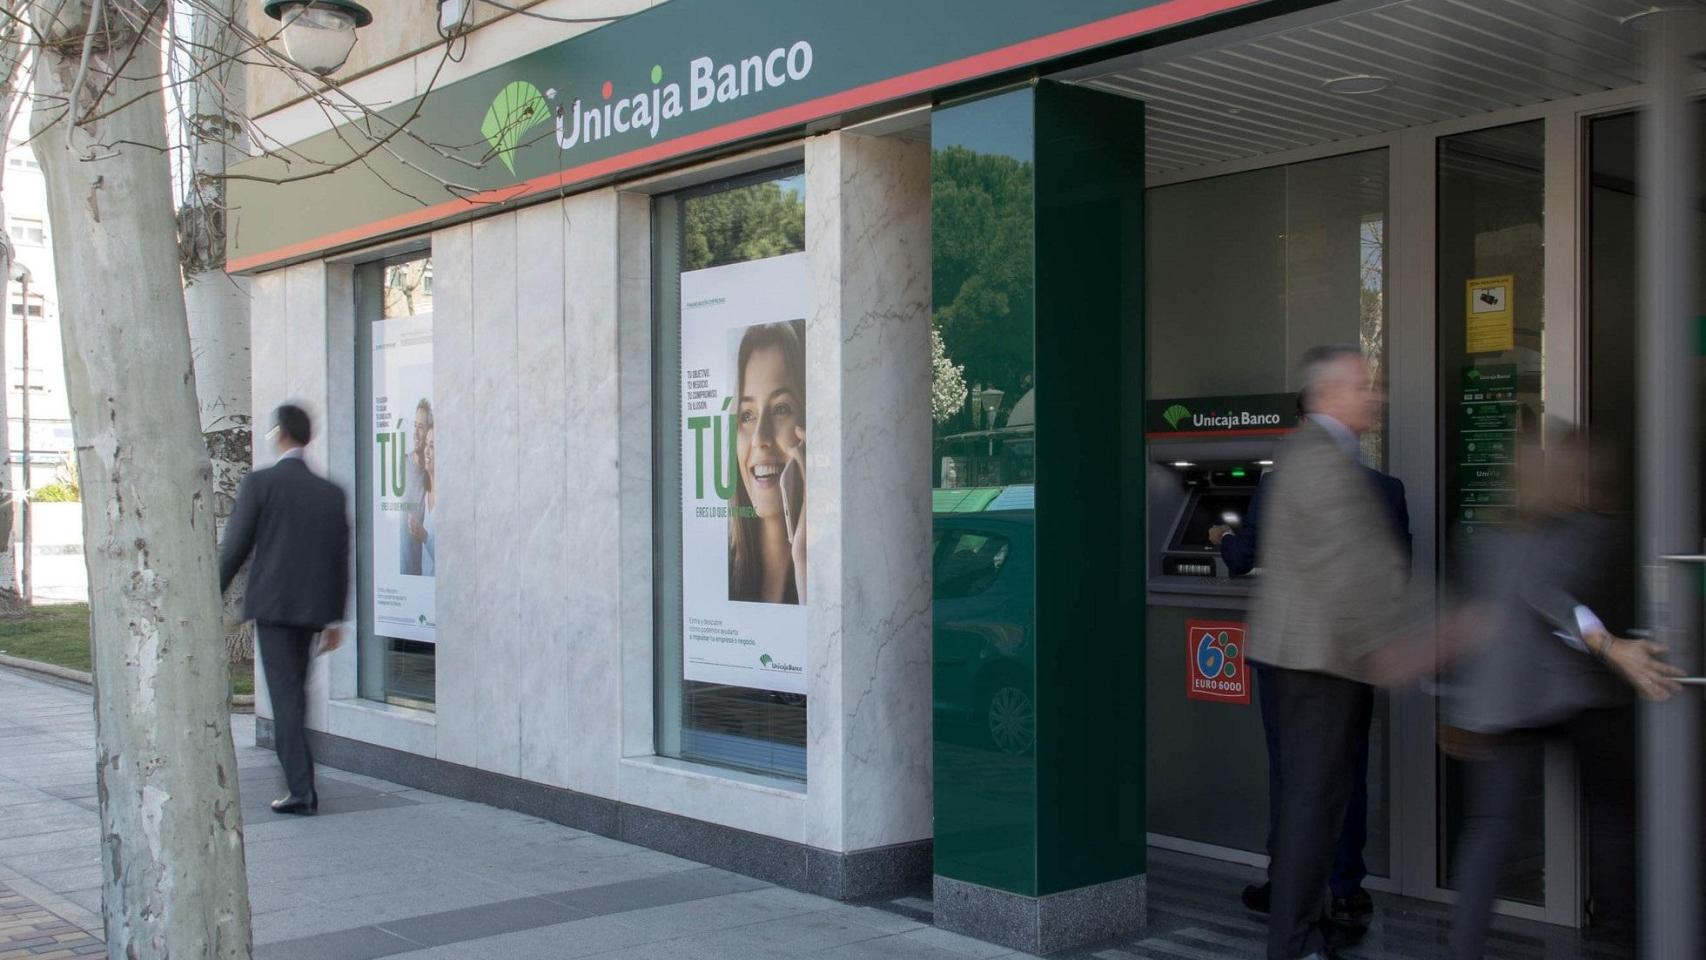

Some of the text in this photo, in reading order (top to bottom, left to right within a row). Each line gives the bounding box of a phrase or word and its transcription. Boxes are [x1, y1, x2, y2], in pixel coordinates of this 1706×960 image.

[556, 40, 813, 149] Unicaja Banco
[376, 418, 406, 497] TÚ
[687, 396, 737, 500] TÚ
[1193, 411, 1280, 429] Unicaja Banco
[1195, 679, 1242, 692] EURO 6000
